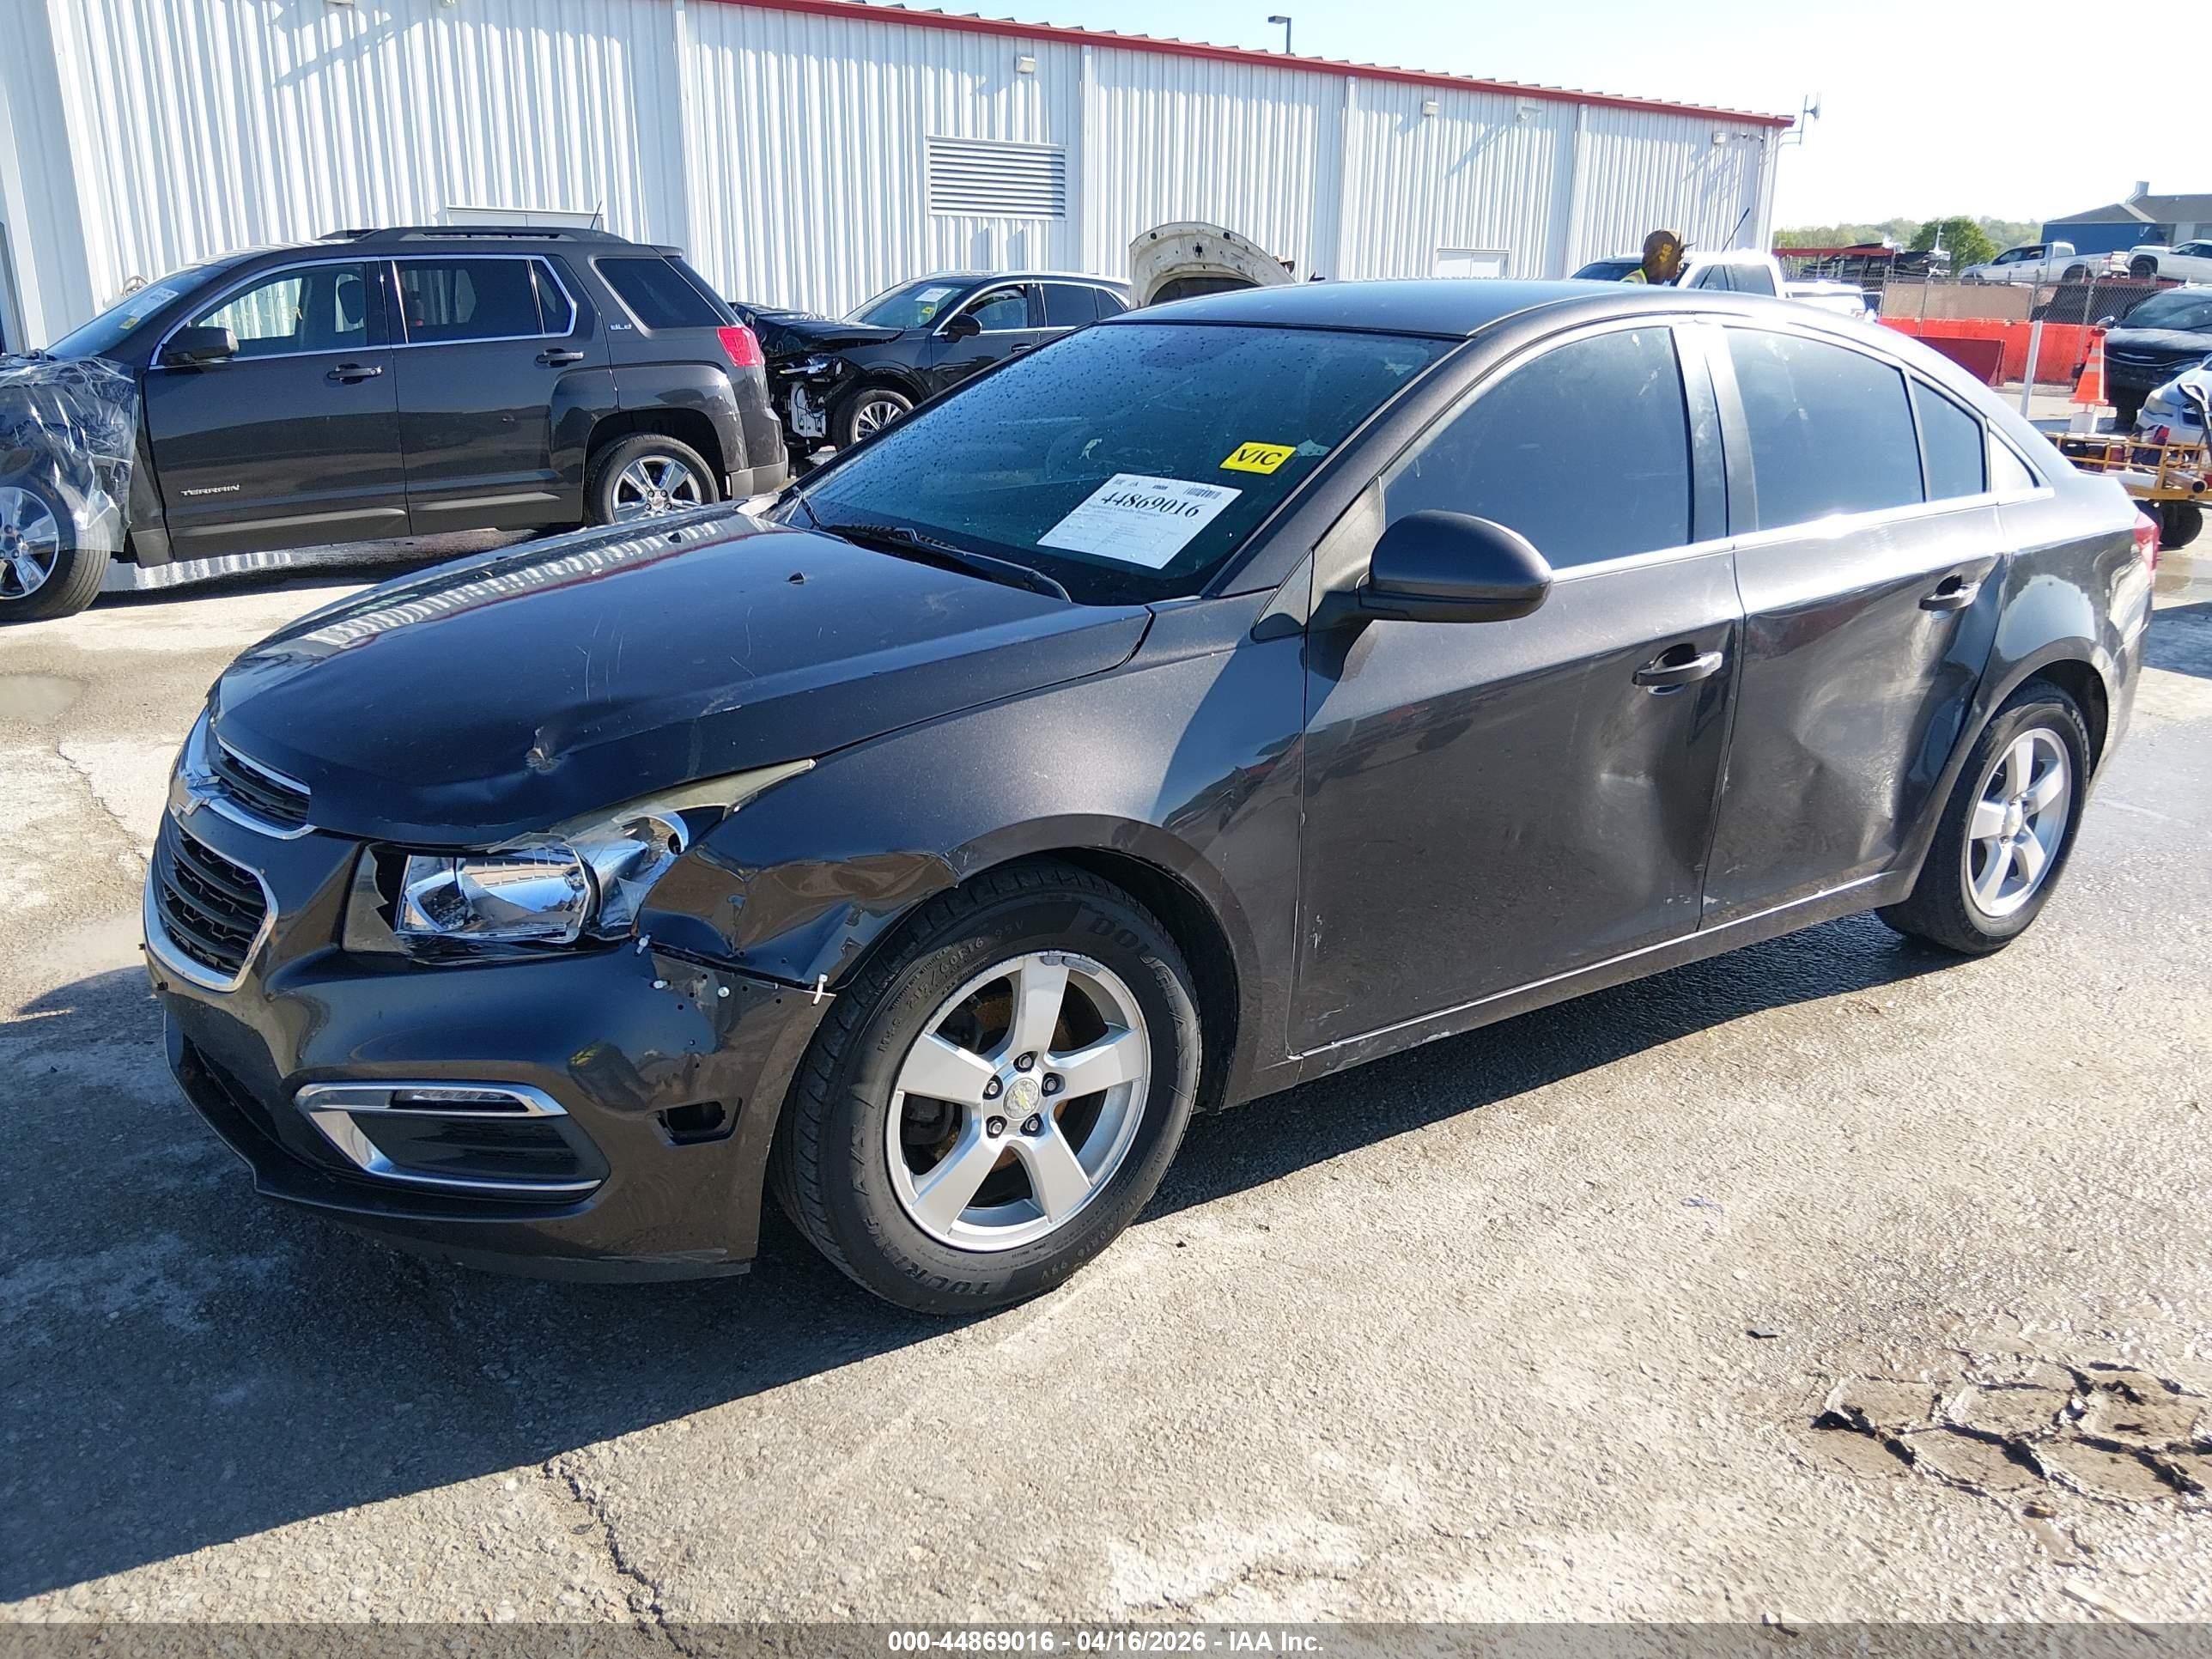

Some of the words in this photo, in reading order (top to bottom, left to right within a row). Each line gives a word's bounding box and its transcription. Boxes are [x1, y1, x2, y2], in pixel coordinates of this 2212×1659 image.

[1237, 448, 1283, 465] VIC
[179, 484, 240, 496] TERRAIN
[1100, 491, 1206, 519] 44869016
[864, 1213, 990, 1296] TOURING
